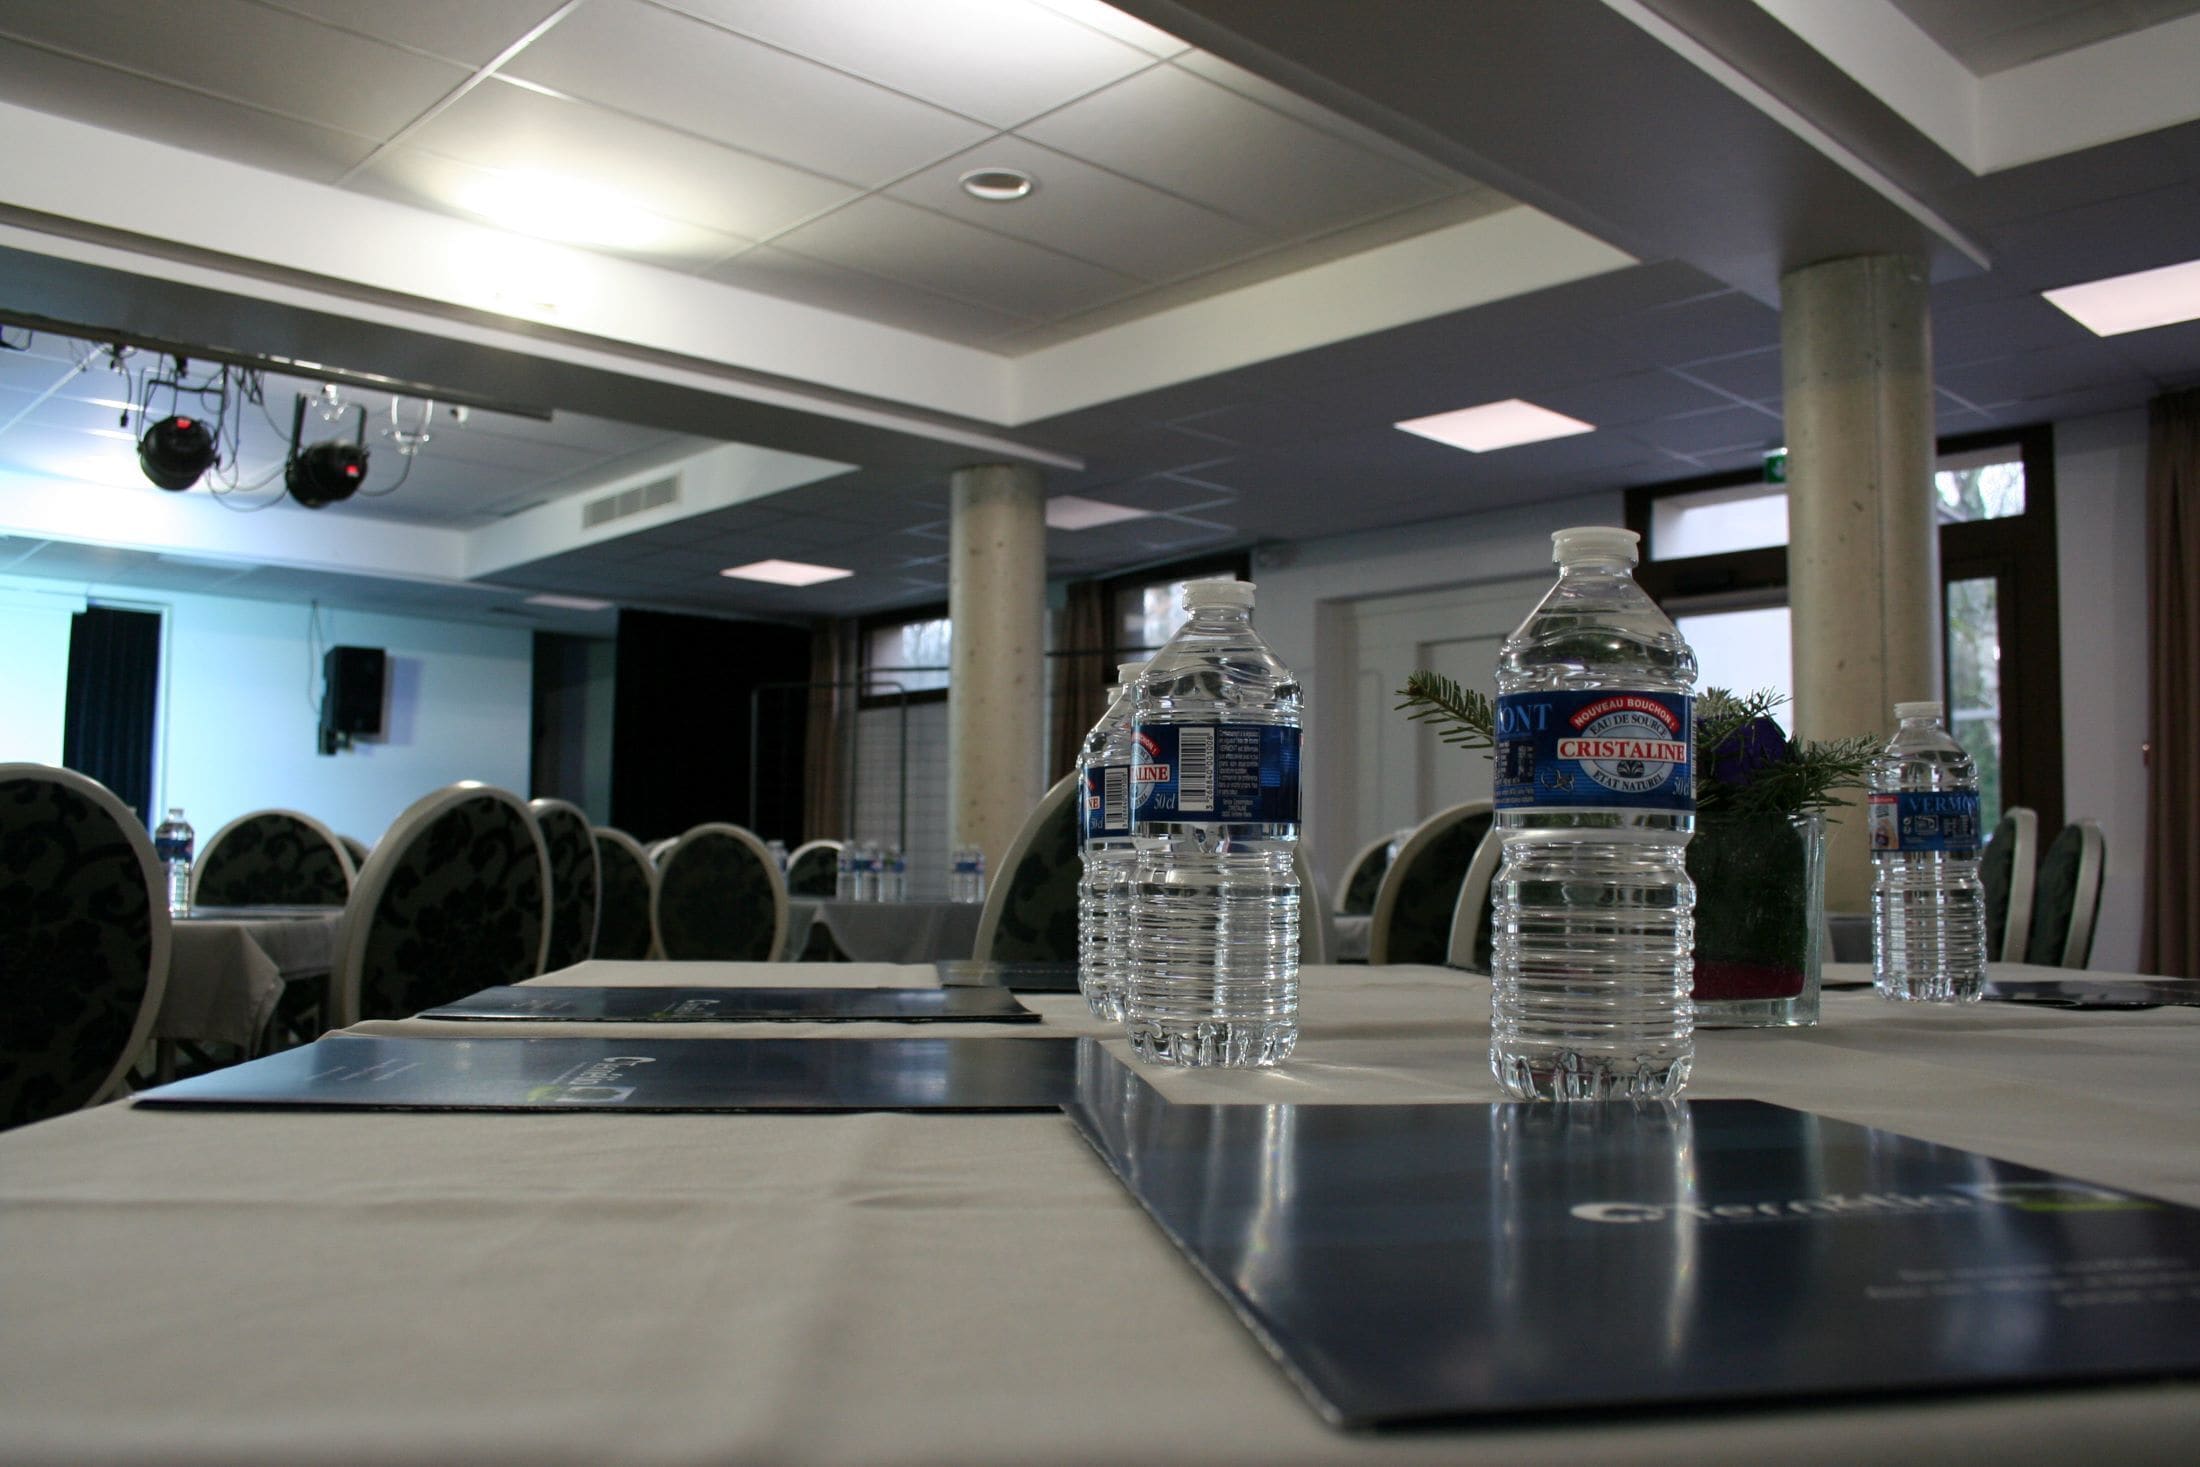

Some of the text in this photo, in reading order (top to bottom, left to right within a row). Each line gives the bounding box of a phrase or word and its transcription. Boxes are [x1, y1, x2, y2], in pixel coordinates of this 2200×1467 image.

[1574, 699, 1623, 727] NOUVEAU
[1590, 713, 1667, 737] EAU DE SOURCE
[1560, 741, 1686, 761] CRISTALINE
[1622, 773, 1664, 792] NATUREL
[1908, 796, 1976, 812] VERMO
